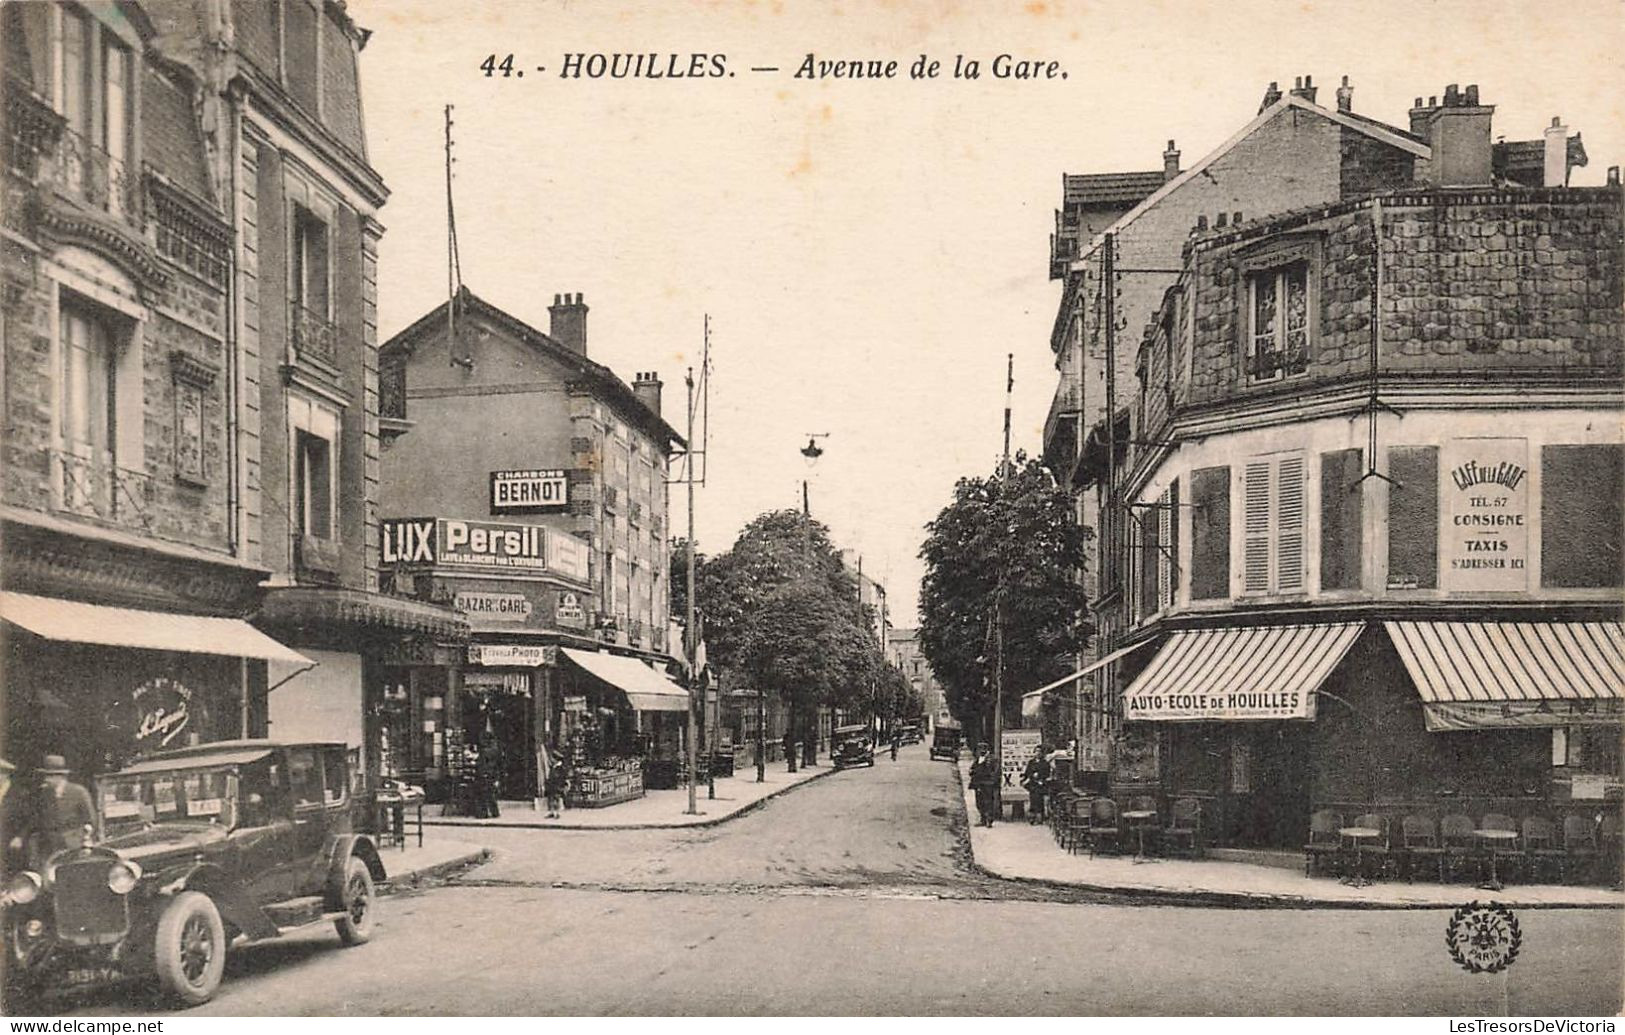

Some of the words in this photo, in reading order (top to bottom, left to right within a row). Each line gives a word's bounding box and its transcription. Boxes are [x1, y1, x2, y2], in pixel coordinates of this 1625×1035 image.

[497, 470, 564, 480] CHARBONS
[1497, 461, 1528, 491] GARE
[499, 481, 562, 502] BERNOT
[1453, 514, 1524, 526] CONSIGNE
[383, 522, 434, 563] LUX
[446, 522, 539, 556] Persil
[1465, 540, 1509, 552] TAXIS
[1452, 559, 1505, 569] S'ADRESSER
[1511, 559, 1524, 569] ICI
[458, 597, 492, 612] BAZAR
[500, 598, 527, 614] GARE
[512, 646, 540, 658] PHOTO
[1131, 695, 1207, 711] AUTO-ECOLE
[1211, 698, 1224, 708] DE
[1228, 692, 1299, 709] HOUILLES
